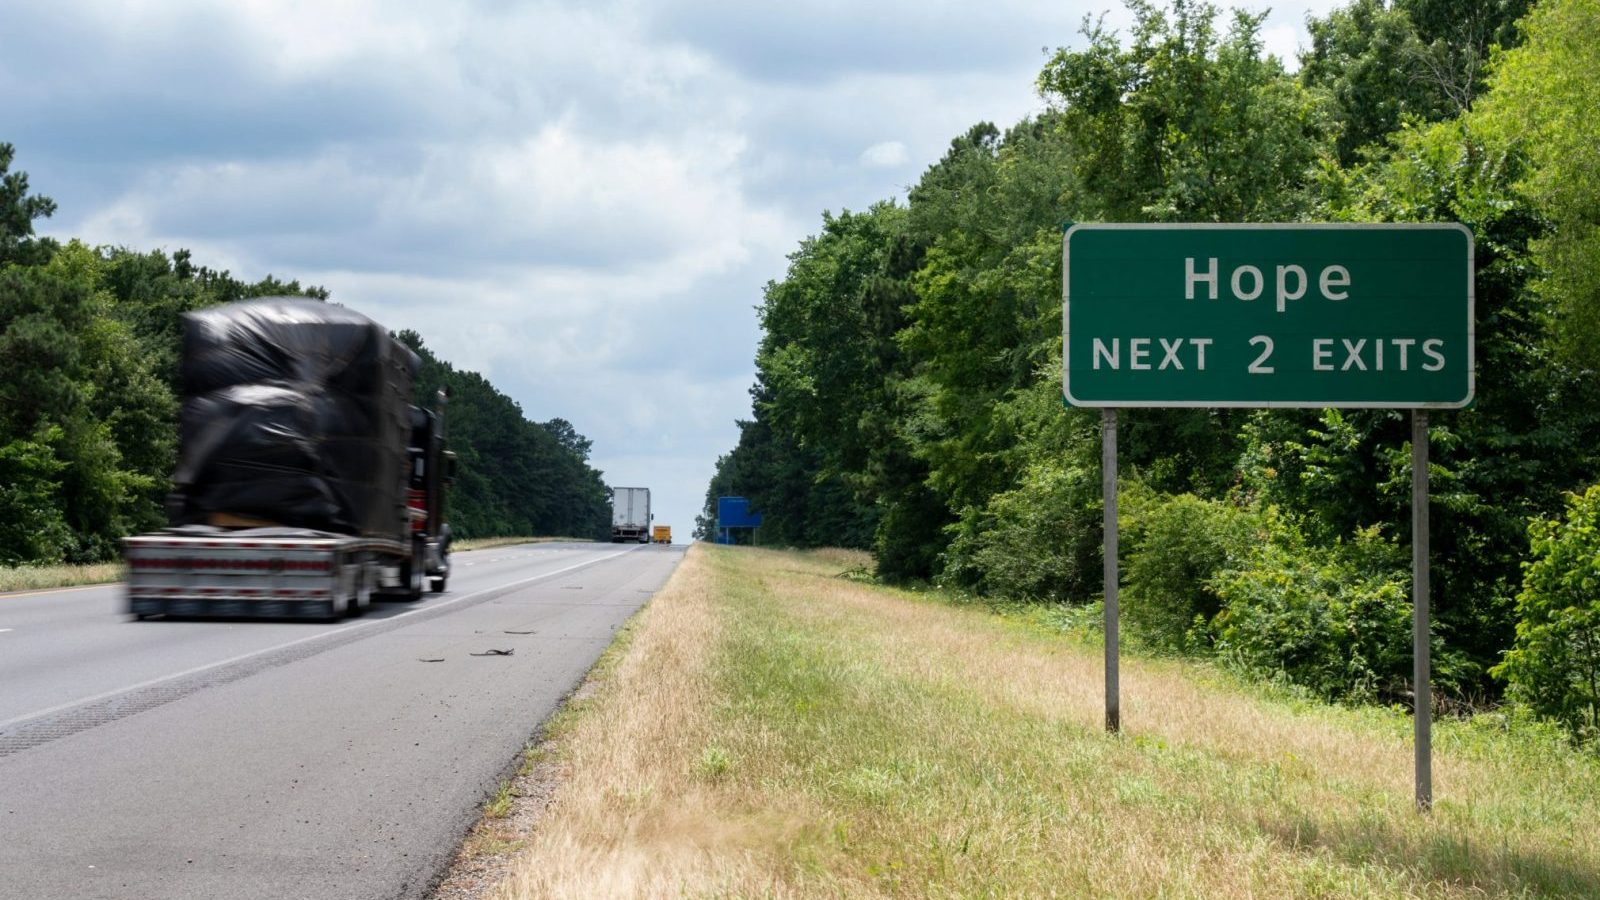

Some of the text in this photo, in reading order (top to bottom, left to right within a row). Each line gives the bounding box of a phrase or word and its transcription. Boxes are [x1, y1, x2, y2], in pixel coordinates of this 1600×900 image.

[1184, 257, 1352, 312] Hope
[1092, 335, 1446, 374] NEXT 2 EXITS
